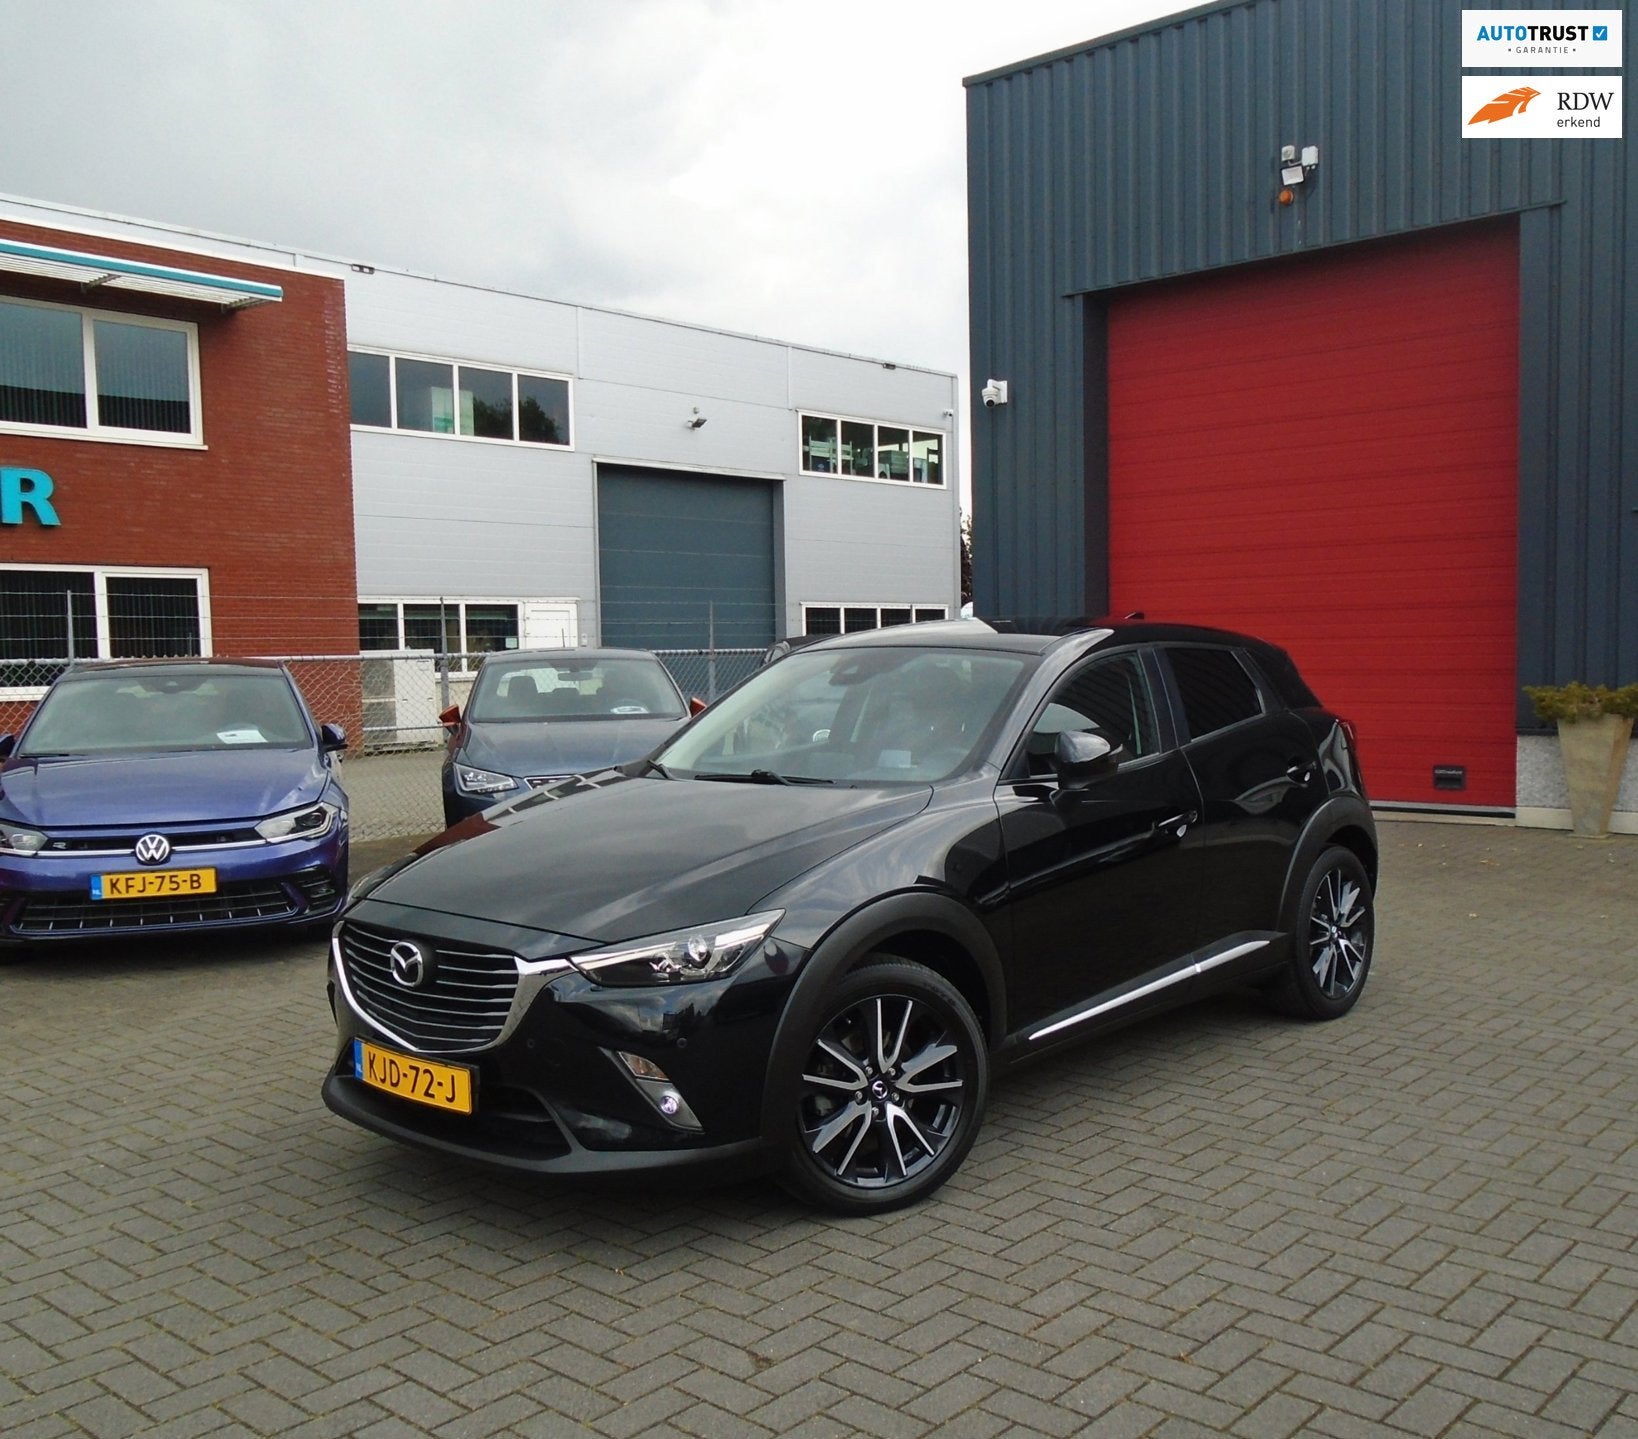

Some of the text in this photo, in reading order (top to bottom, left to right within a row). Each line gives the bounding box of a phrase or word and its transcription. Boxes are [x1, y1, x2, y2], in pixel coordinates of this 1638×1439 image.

[0, 466, 61, 526] R
[109, 873, 202, 895] KFJ-75-B
[368, 1050, 456, 1104] KJD-72-J
